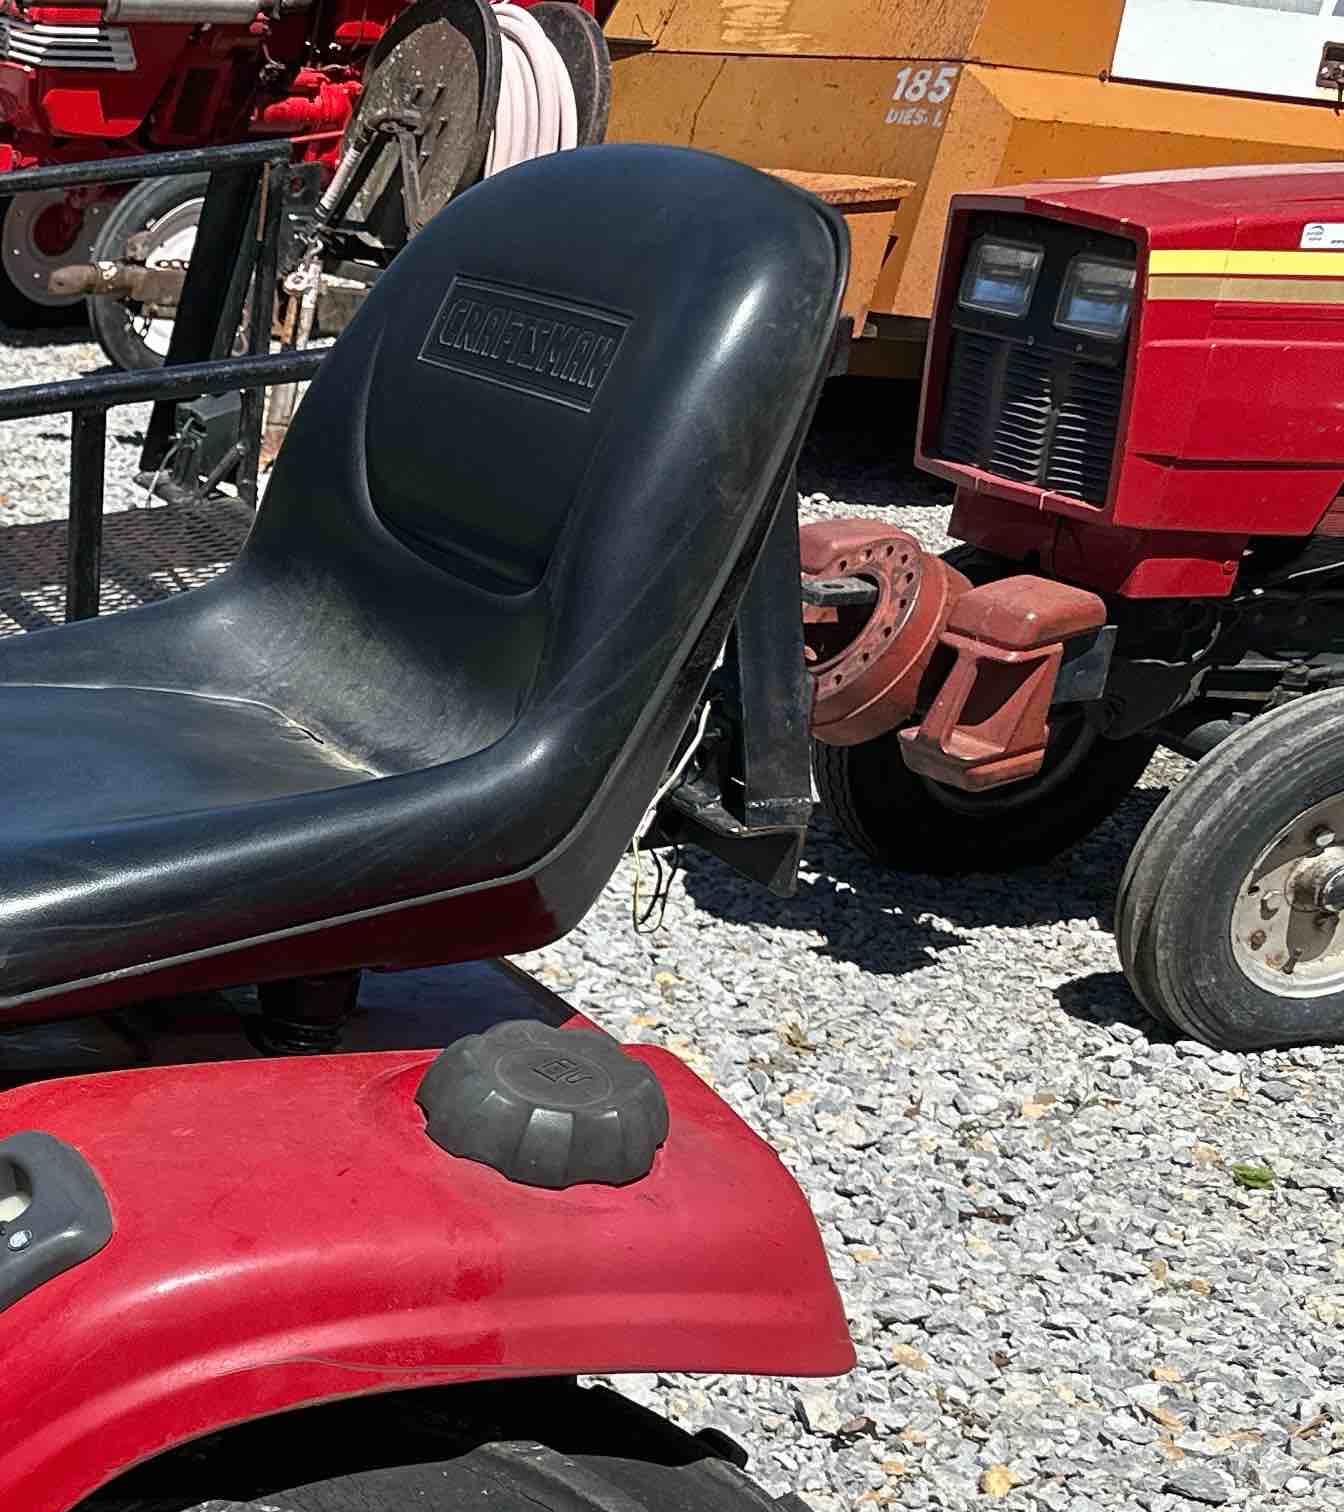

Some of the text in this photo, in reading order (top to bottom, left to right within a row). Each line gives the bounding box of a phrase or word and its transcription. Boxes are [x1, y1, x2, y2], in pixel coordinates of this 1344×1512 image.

[893, 66, 959, 103] 185
[885, 108, 945, 128] DIESL
[438, 299, 617, 388] CRAFTSMAN
